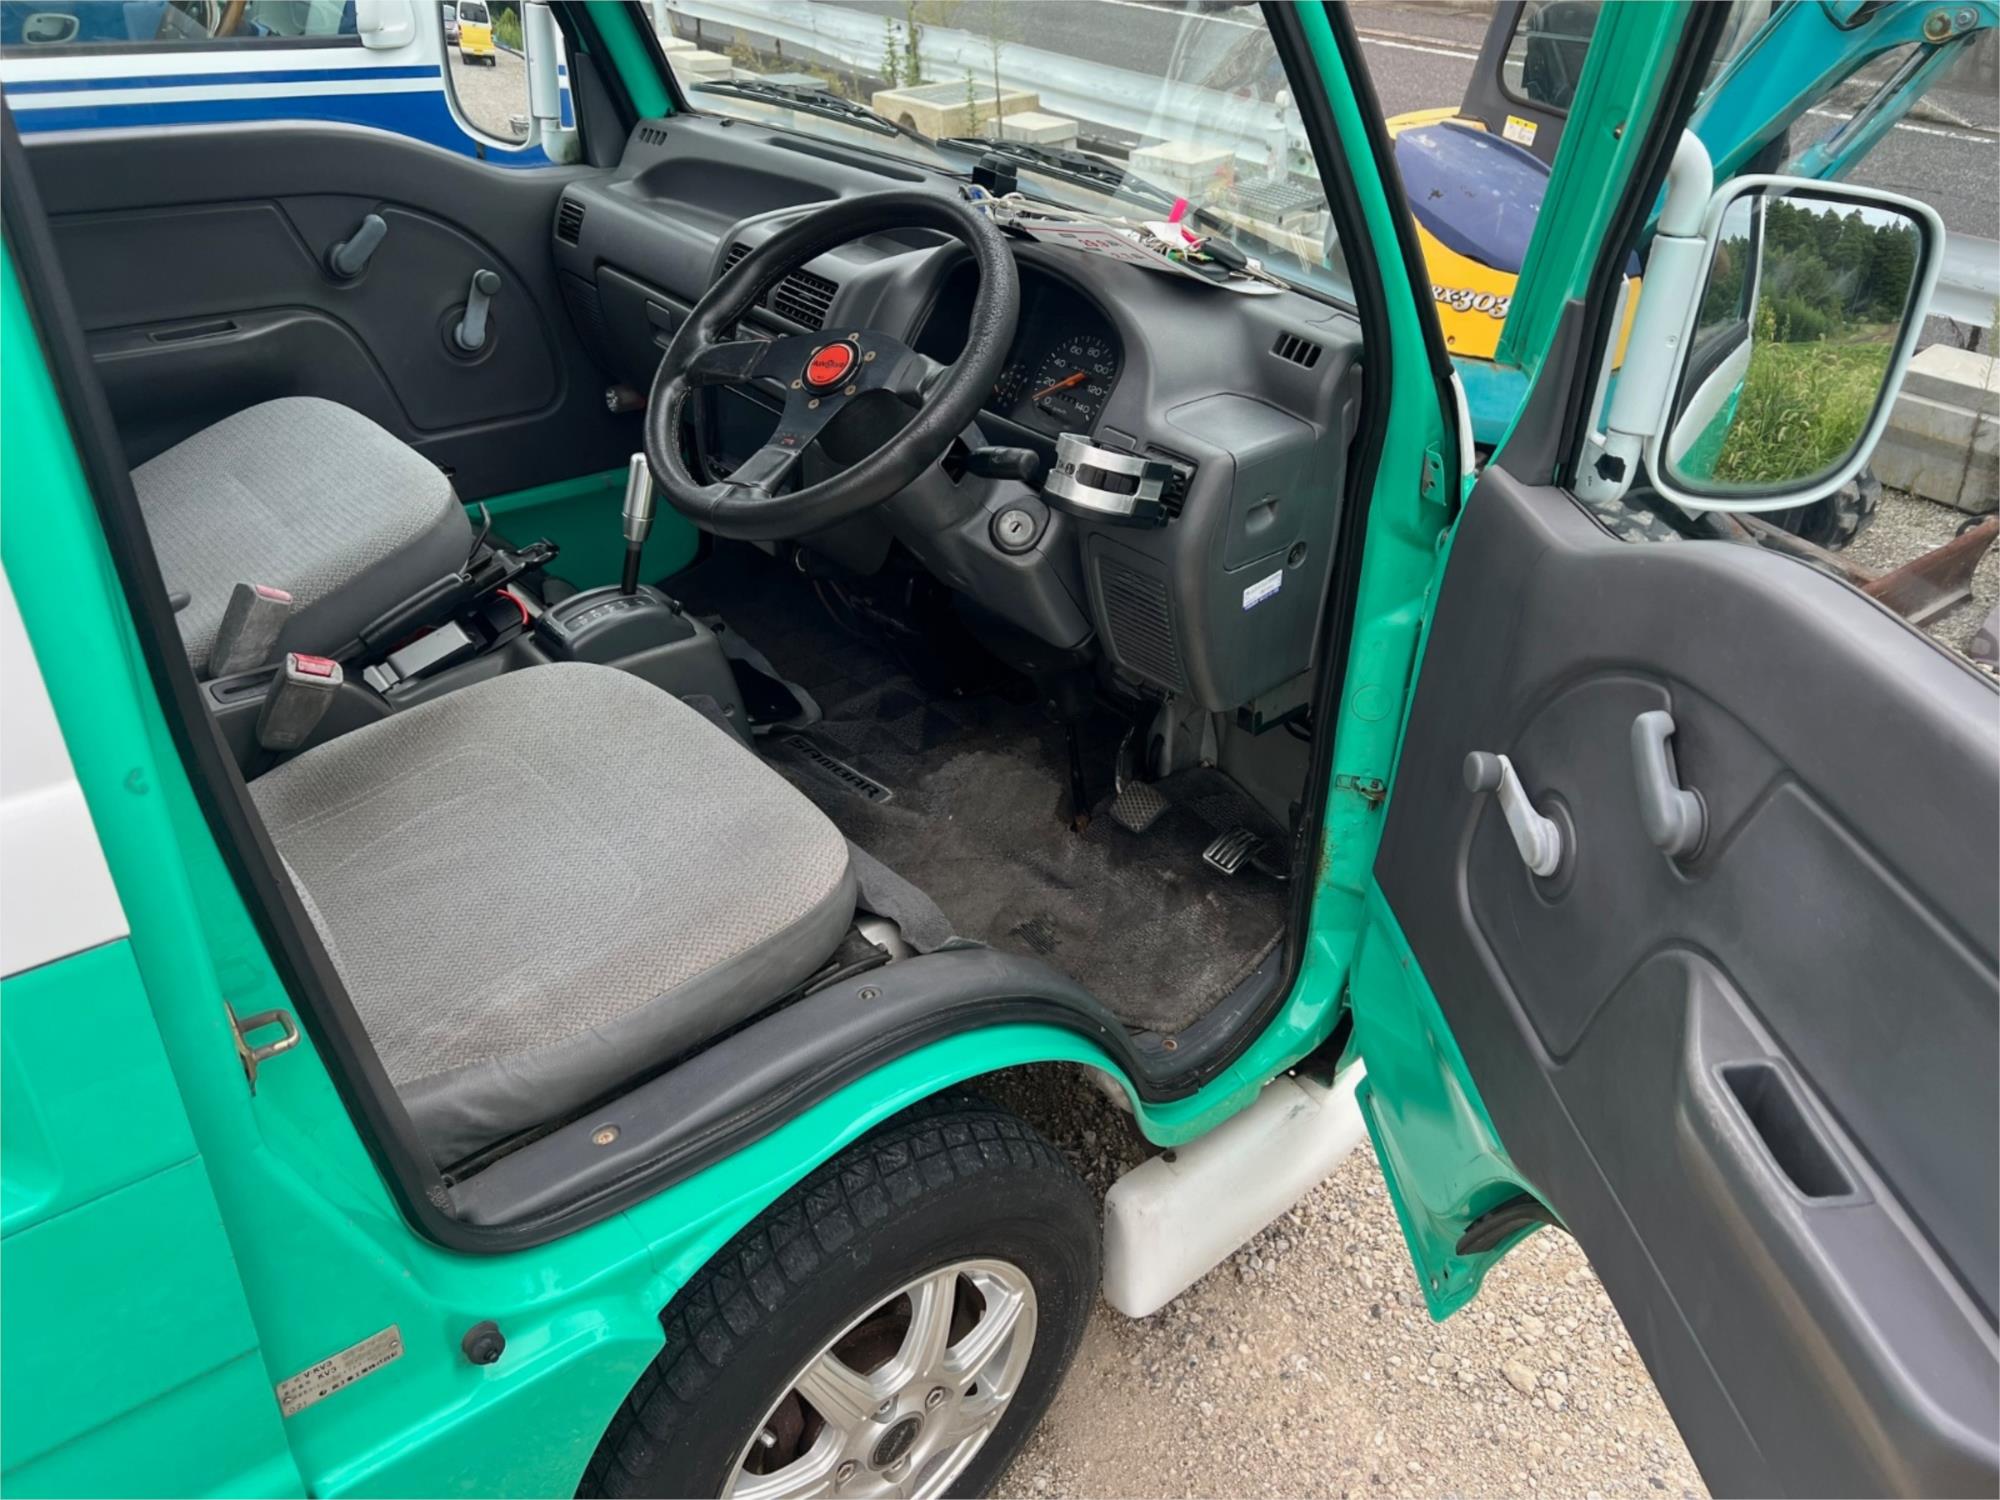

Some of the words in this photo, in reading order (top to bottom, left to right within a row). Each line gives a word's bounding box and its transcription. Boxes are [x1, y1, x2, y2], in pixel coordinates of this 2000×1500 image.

[1070, 345, 1083, 355] 60
[1087, 346, 1100, 358] 80
[1054, 358, 1066, 368] 40
[1094, 363, 1109, 375] 100
[1043, 376, 1056, 387] 20
[1088, 384, 1103, 396] 120
[1044, 396, 1052, 405] 0
[1075, 401, 1090, 414] 140
[787, 739, 880, 799] SAMBAR
